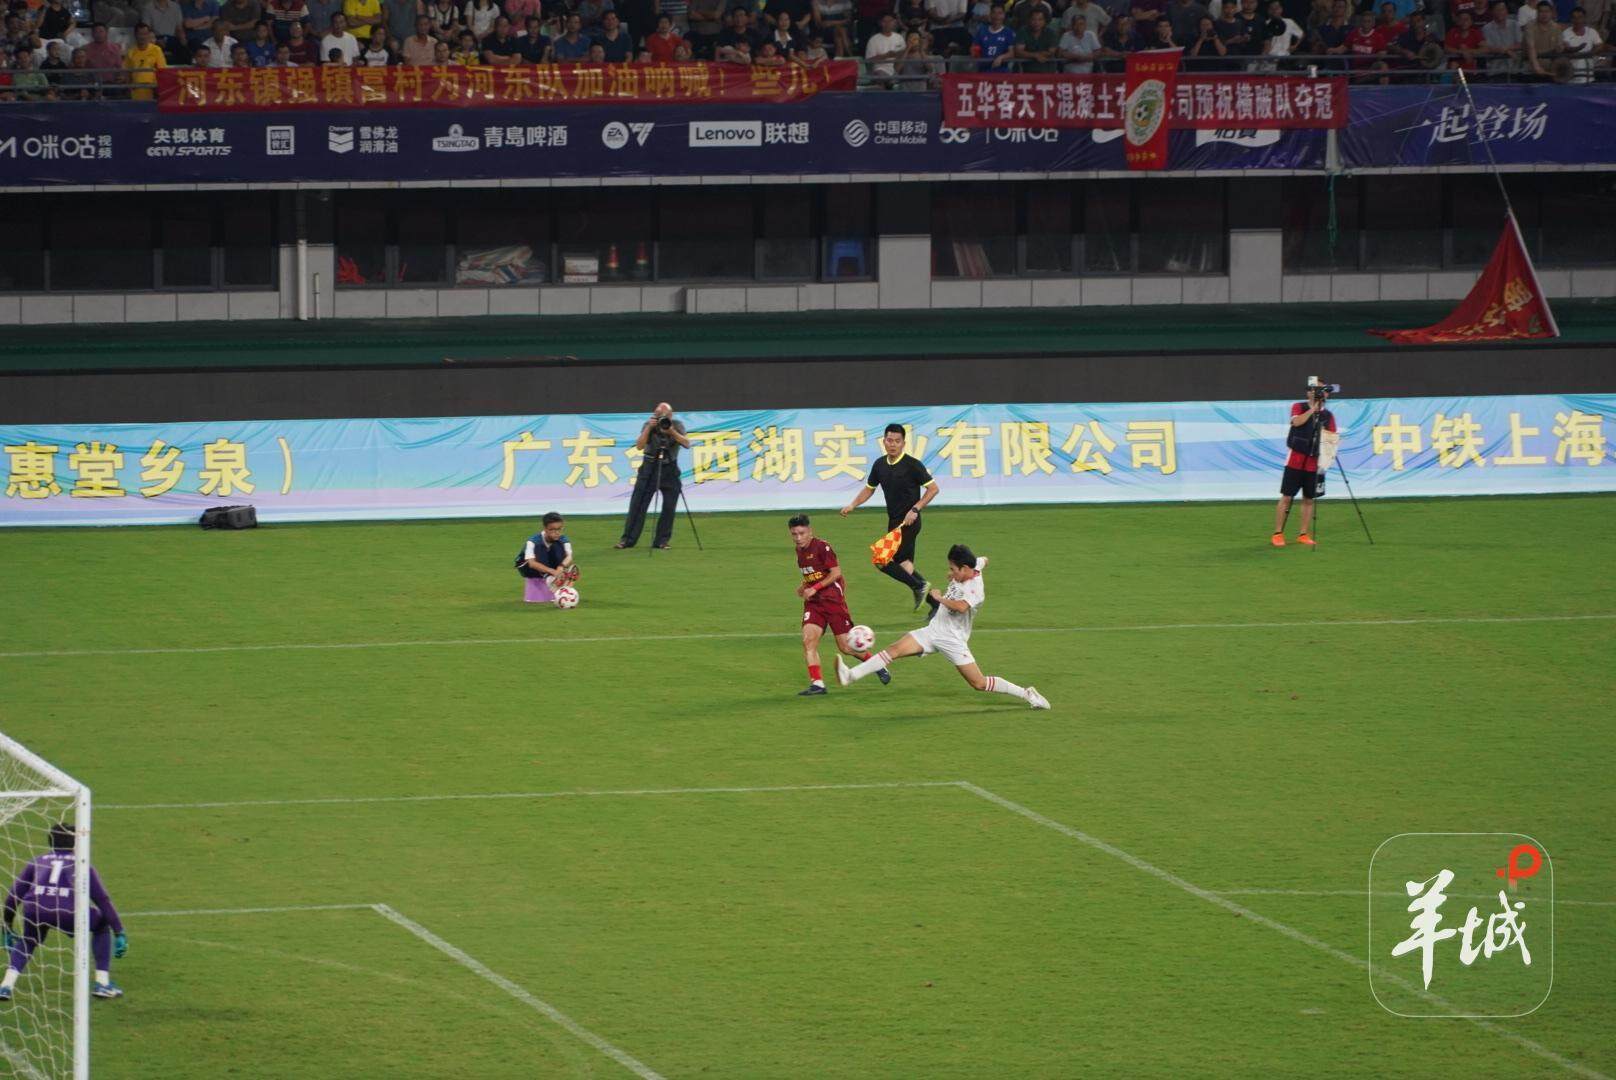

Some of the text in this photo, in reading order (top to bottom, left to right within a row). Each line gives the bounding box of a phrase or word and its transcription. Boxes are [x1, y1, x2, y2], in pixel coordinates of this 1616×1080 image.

[764, 122, 809, 143] 联想
[874, 119, 928, 134] 中国移动
[1396, 102, 1549, 148] 一起登场
[153, 128, 225, 144] 央视体育
[359, 127, 398, 140] 雪佛龙
[695, 126, 756, 143] Lenovo
[874, 134, 899, 144] China
[23, 133, 96, 159] 咪咕
[176, 145, 232, 157] SPORTS
[359, 140, 398, 154] 润滑油
[1372, 410, 1607, 472] 中铁上海
[48, 860, 64, 884] 1
